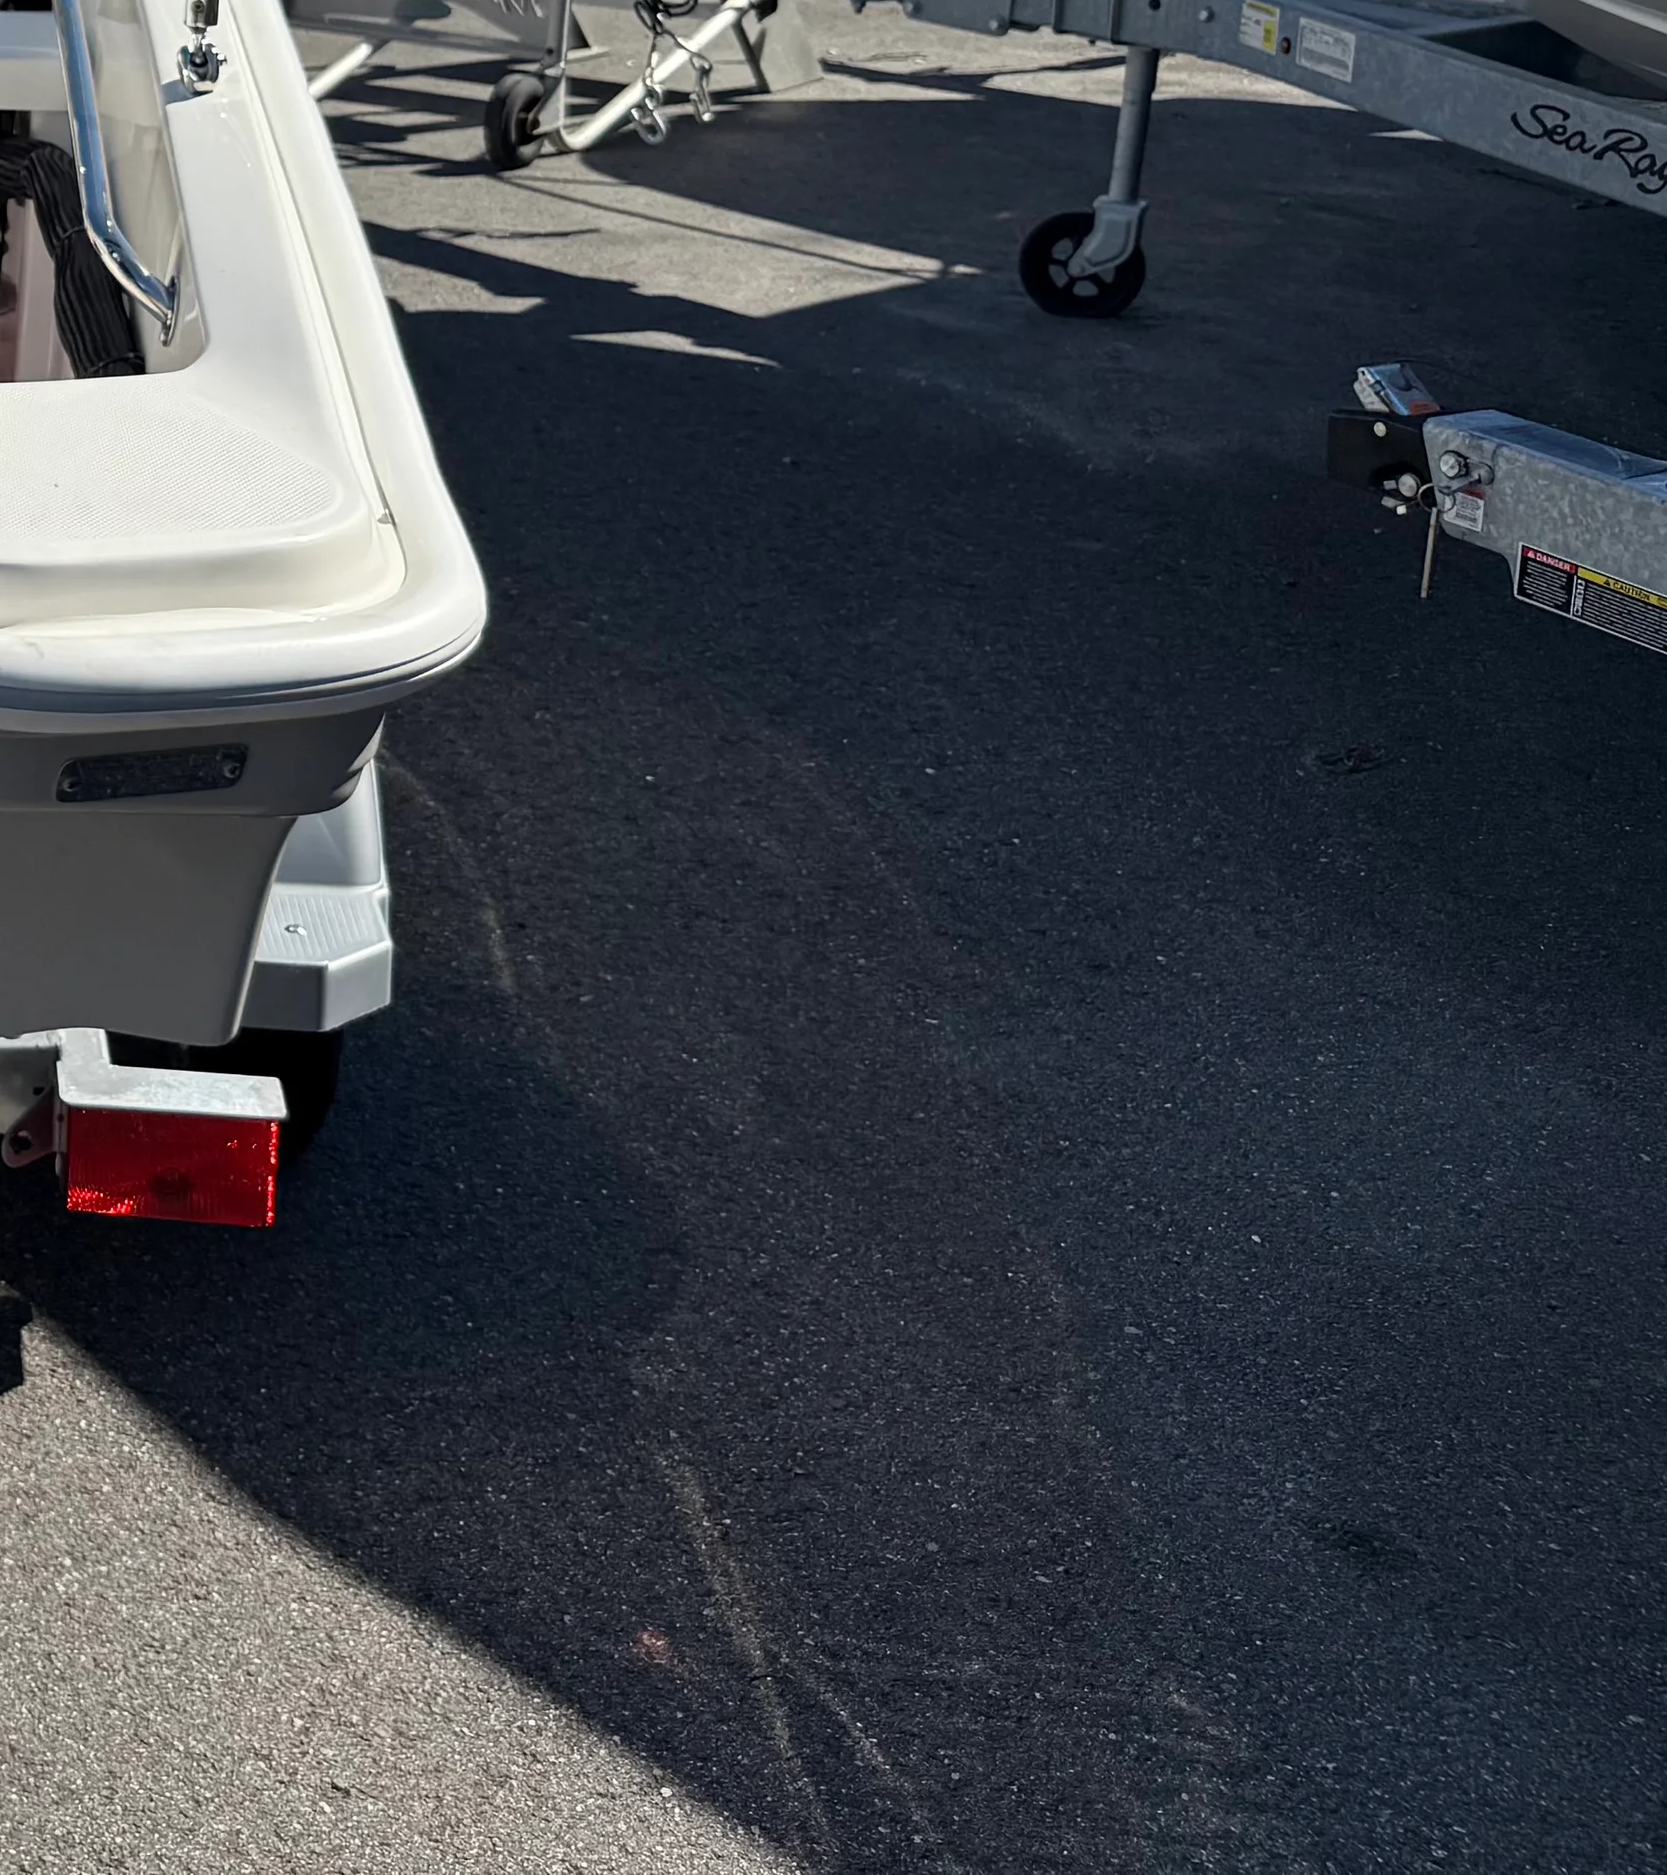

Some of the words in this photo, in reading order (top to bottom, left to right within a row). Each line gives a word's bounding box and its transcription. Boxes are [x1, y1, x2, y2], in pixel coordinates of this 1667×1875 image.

[1510, 104, 1597, 153] Sea
[1535, 551, 1571, 573] DANGER
[1613, 581, 1650, 601] CAUTION
